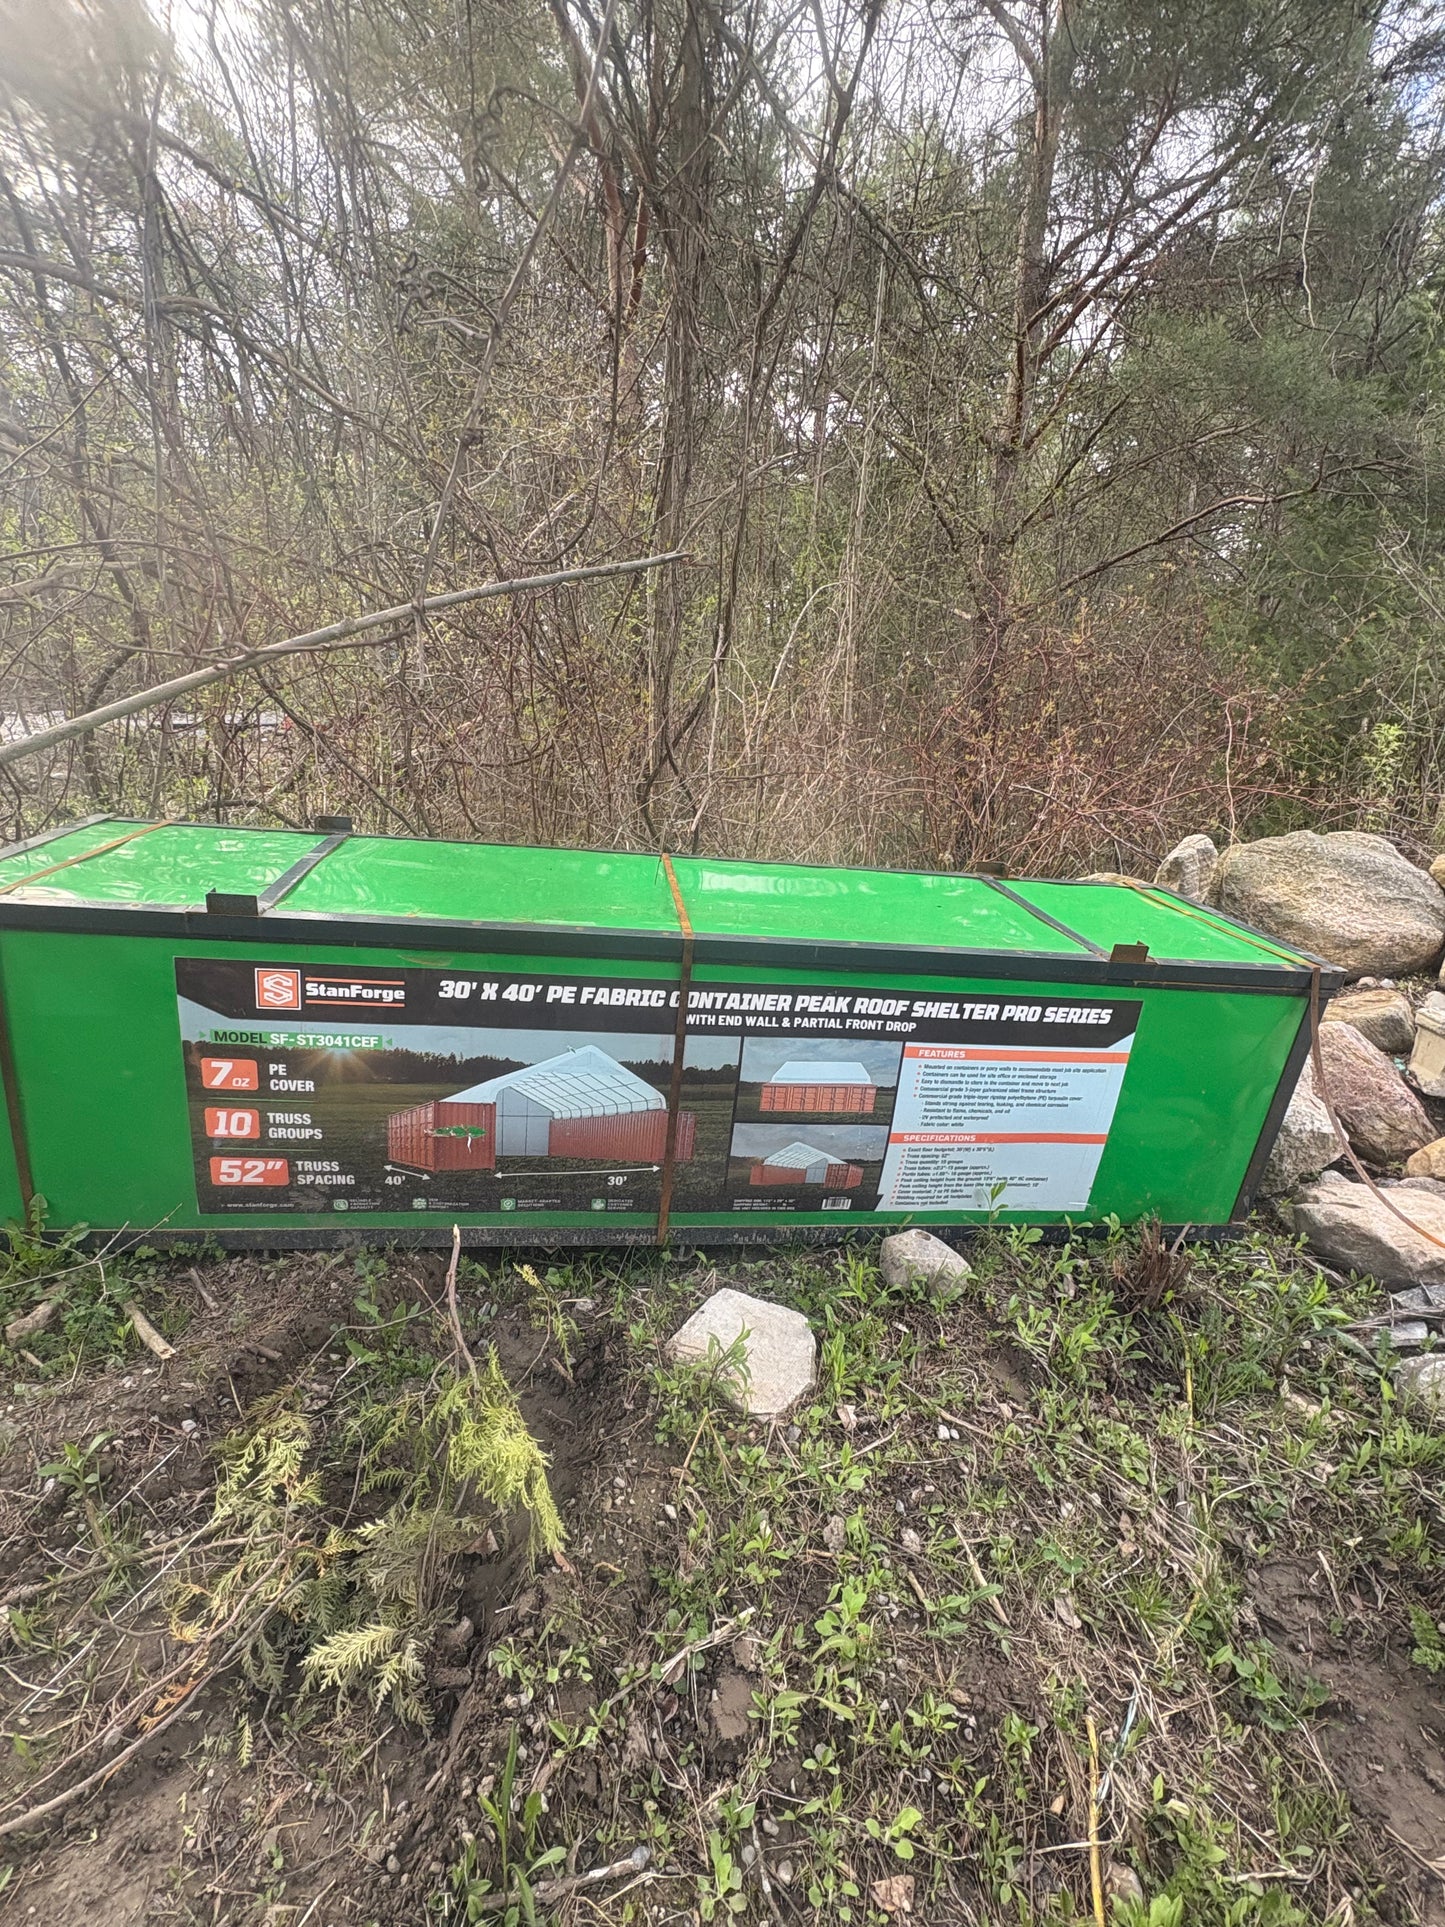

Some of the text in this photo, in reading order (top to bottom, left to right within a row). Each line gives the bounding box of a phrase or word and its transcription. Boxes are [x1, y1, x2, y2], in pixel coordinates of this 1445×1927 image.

[305, 983, 405, 1002] StanForge
[438, 980, 1113, 1024] 30' X 40' PE FABRIC CONTAINER PEAK ROOF SHELTER PRO SERIES
[686, 1014, 916, 1032] WITH END WALL & PARTIAL FRONT DROP
[214, 1031, 267, 1044] MODEL
[919, 1050, 966, 1058] FEATURES
[210, 1061, 233, 1086] 7
[269, 1063, 287, 1075] PE
[270, 1079, 315, 1092] COVER
[214, 1111, 252, 1136] 10
[267, 1112, 311, 1125] TRUSS
[268, 1127, 323, 1140] GROUPS
[219, 1160, 284, 1183] 52"
[296, 1161, 339, 1172] TRUSS
[297, 1174, 356, 1186] SPACING
